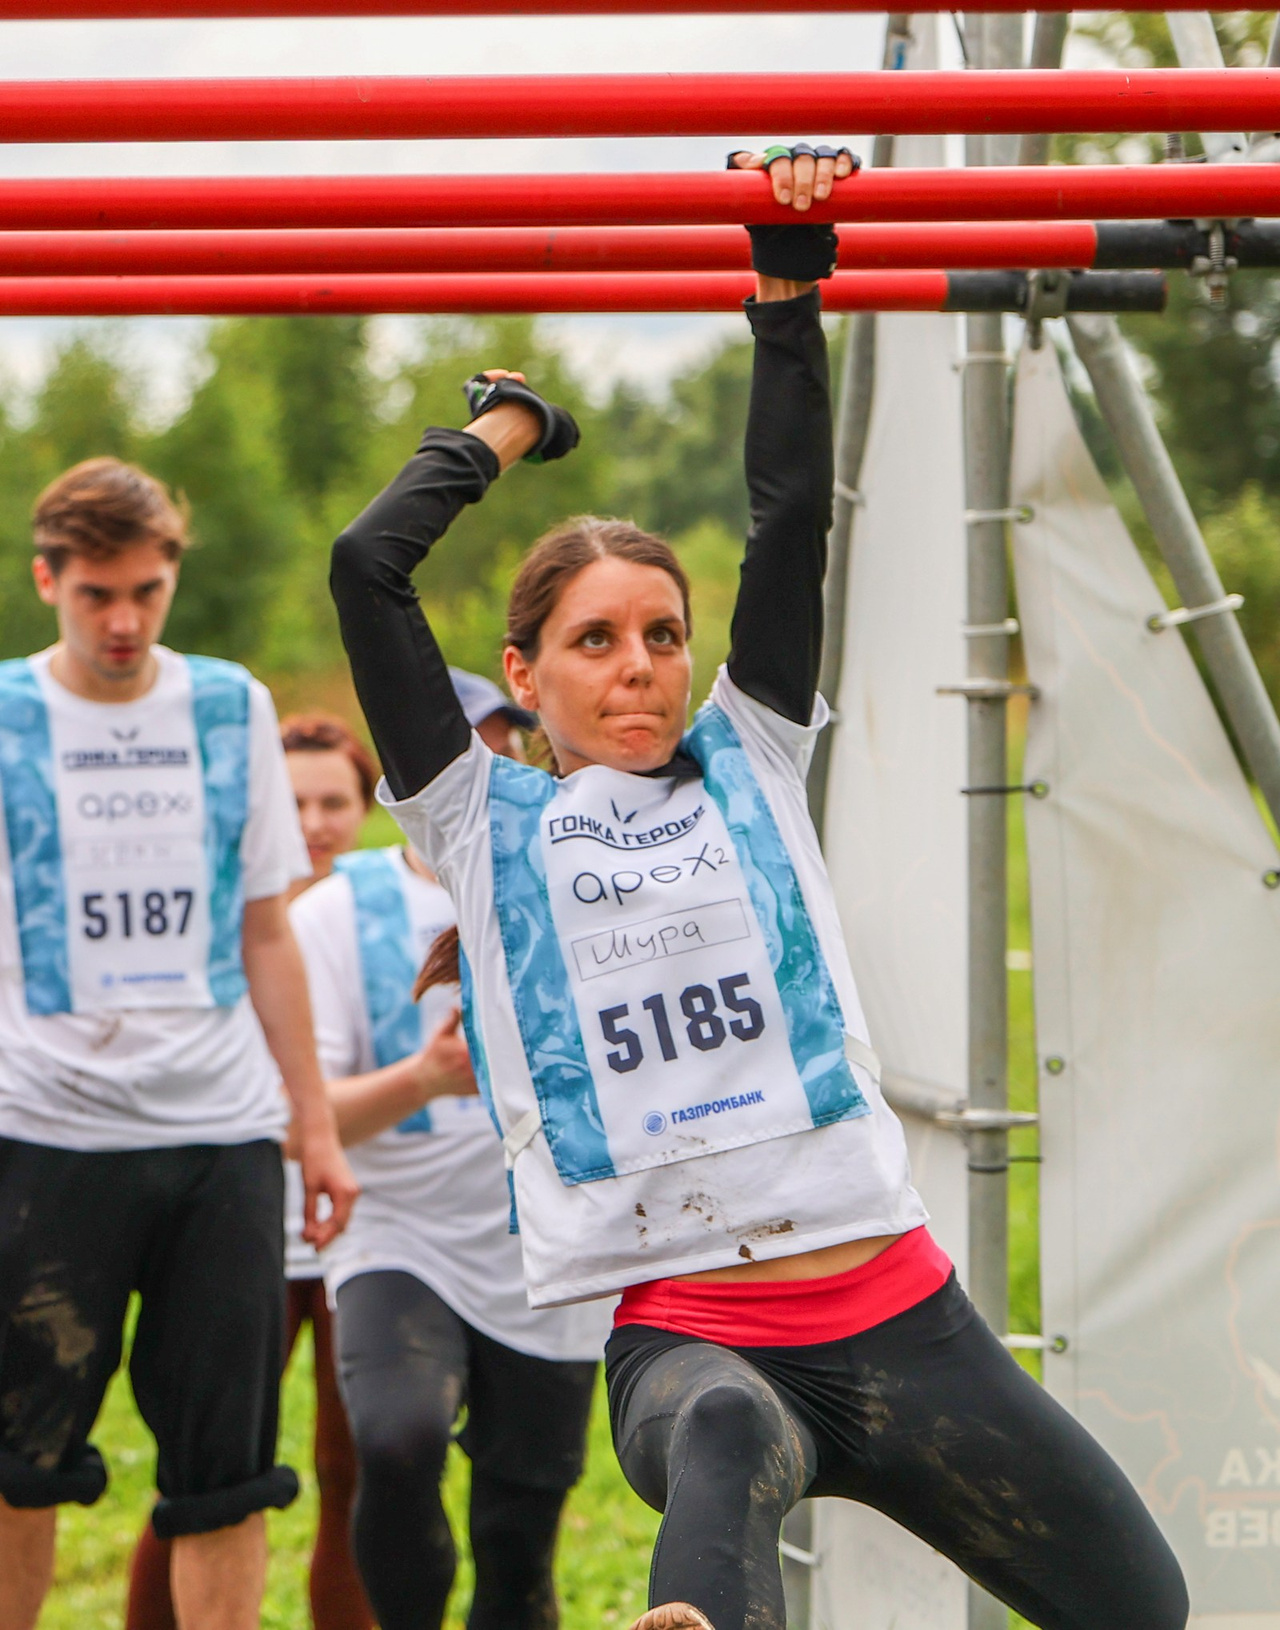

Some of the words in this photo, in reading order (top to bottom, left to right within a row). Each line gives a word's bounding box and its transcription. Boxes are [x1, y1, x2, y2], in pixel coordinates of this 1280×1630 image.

[549, 815, 617, 844] ГОНКА
[83, 889, 193, 939] 5187
[591, 920, 706, 965] Шура
[598, 972, 766, 1074] 5185
[670, 1089, 766, 1125] ГАЗПРОМБАНК
